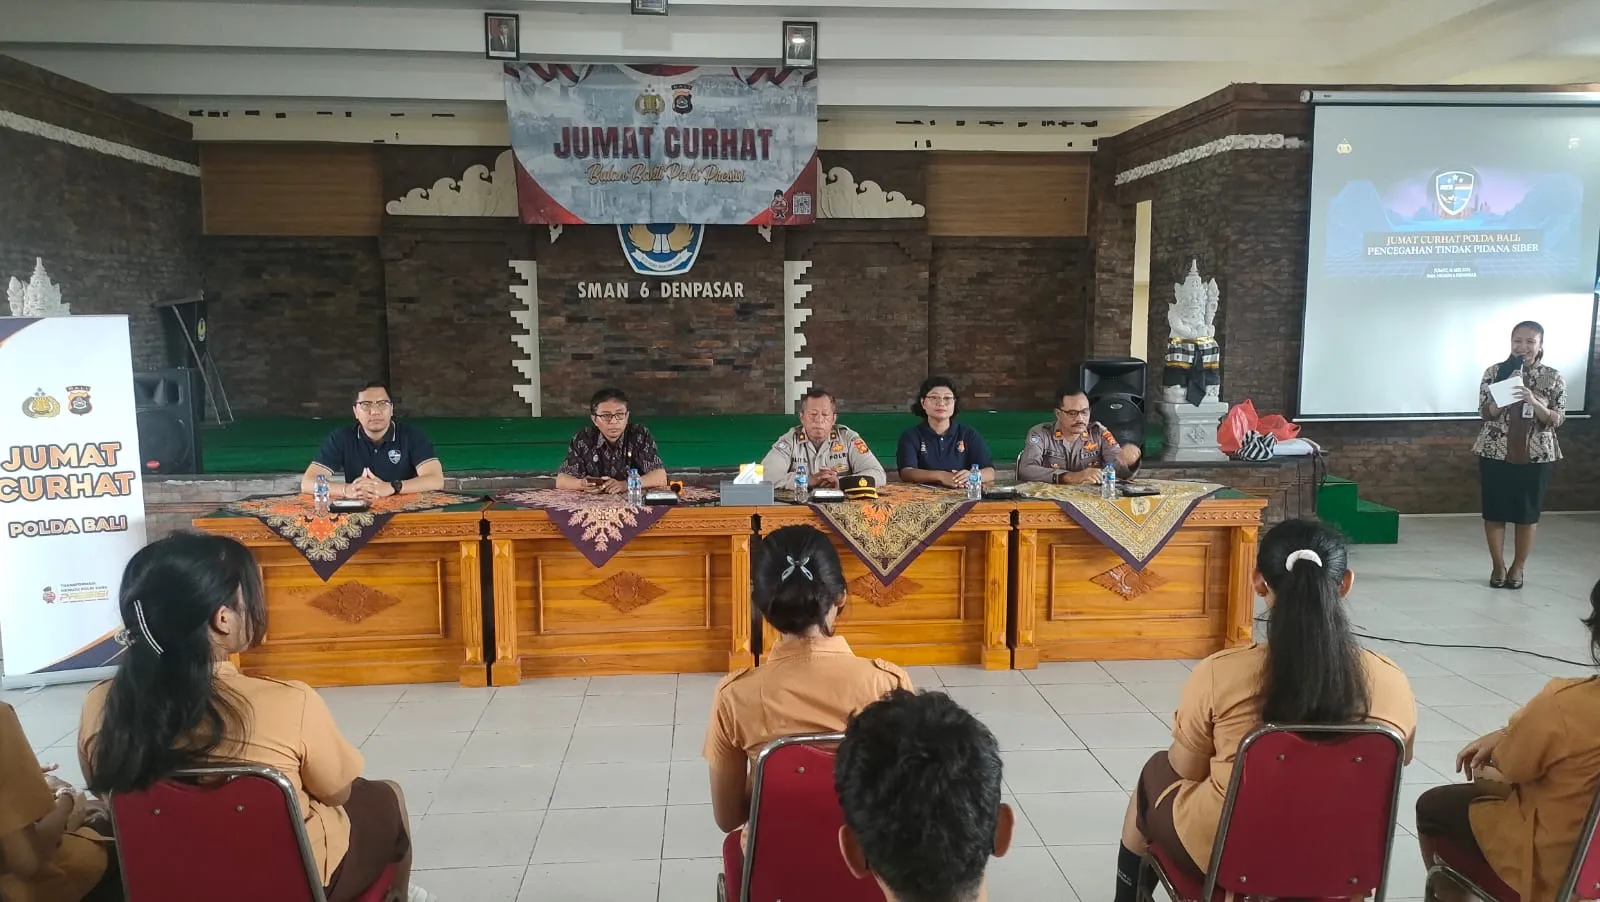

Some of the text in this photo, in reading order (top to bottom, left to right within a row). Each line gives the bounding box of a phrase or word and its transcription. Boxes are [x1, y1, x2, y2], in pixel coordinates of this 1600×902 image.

[553, 126, 773, 160] JUMAT CURHAT
[588, 163, 627, 185] Bulan
[630, 163, 665, 185] Bakti
[1367, 243, 1539, 256] PENCEGAHAN TINDAK PIDANA SIBER
[1385, 236, 1418, 246] JUMAT
[1420, 235, 1460, 245] CURHAT
[1463, 234, 1494, 243] POLDA
[577, 281, 744, 299] SMAN 6 DENPASAR
[1, 442, 121, 472] JUMAT
[0, 471, 136, 503] CURHAT
[8, 514, 128, 538] POLDA BALI
